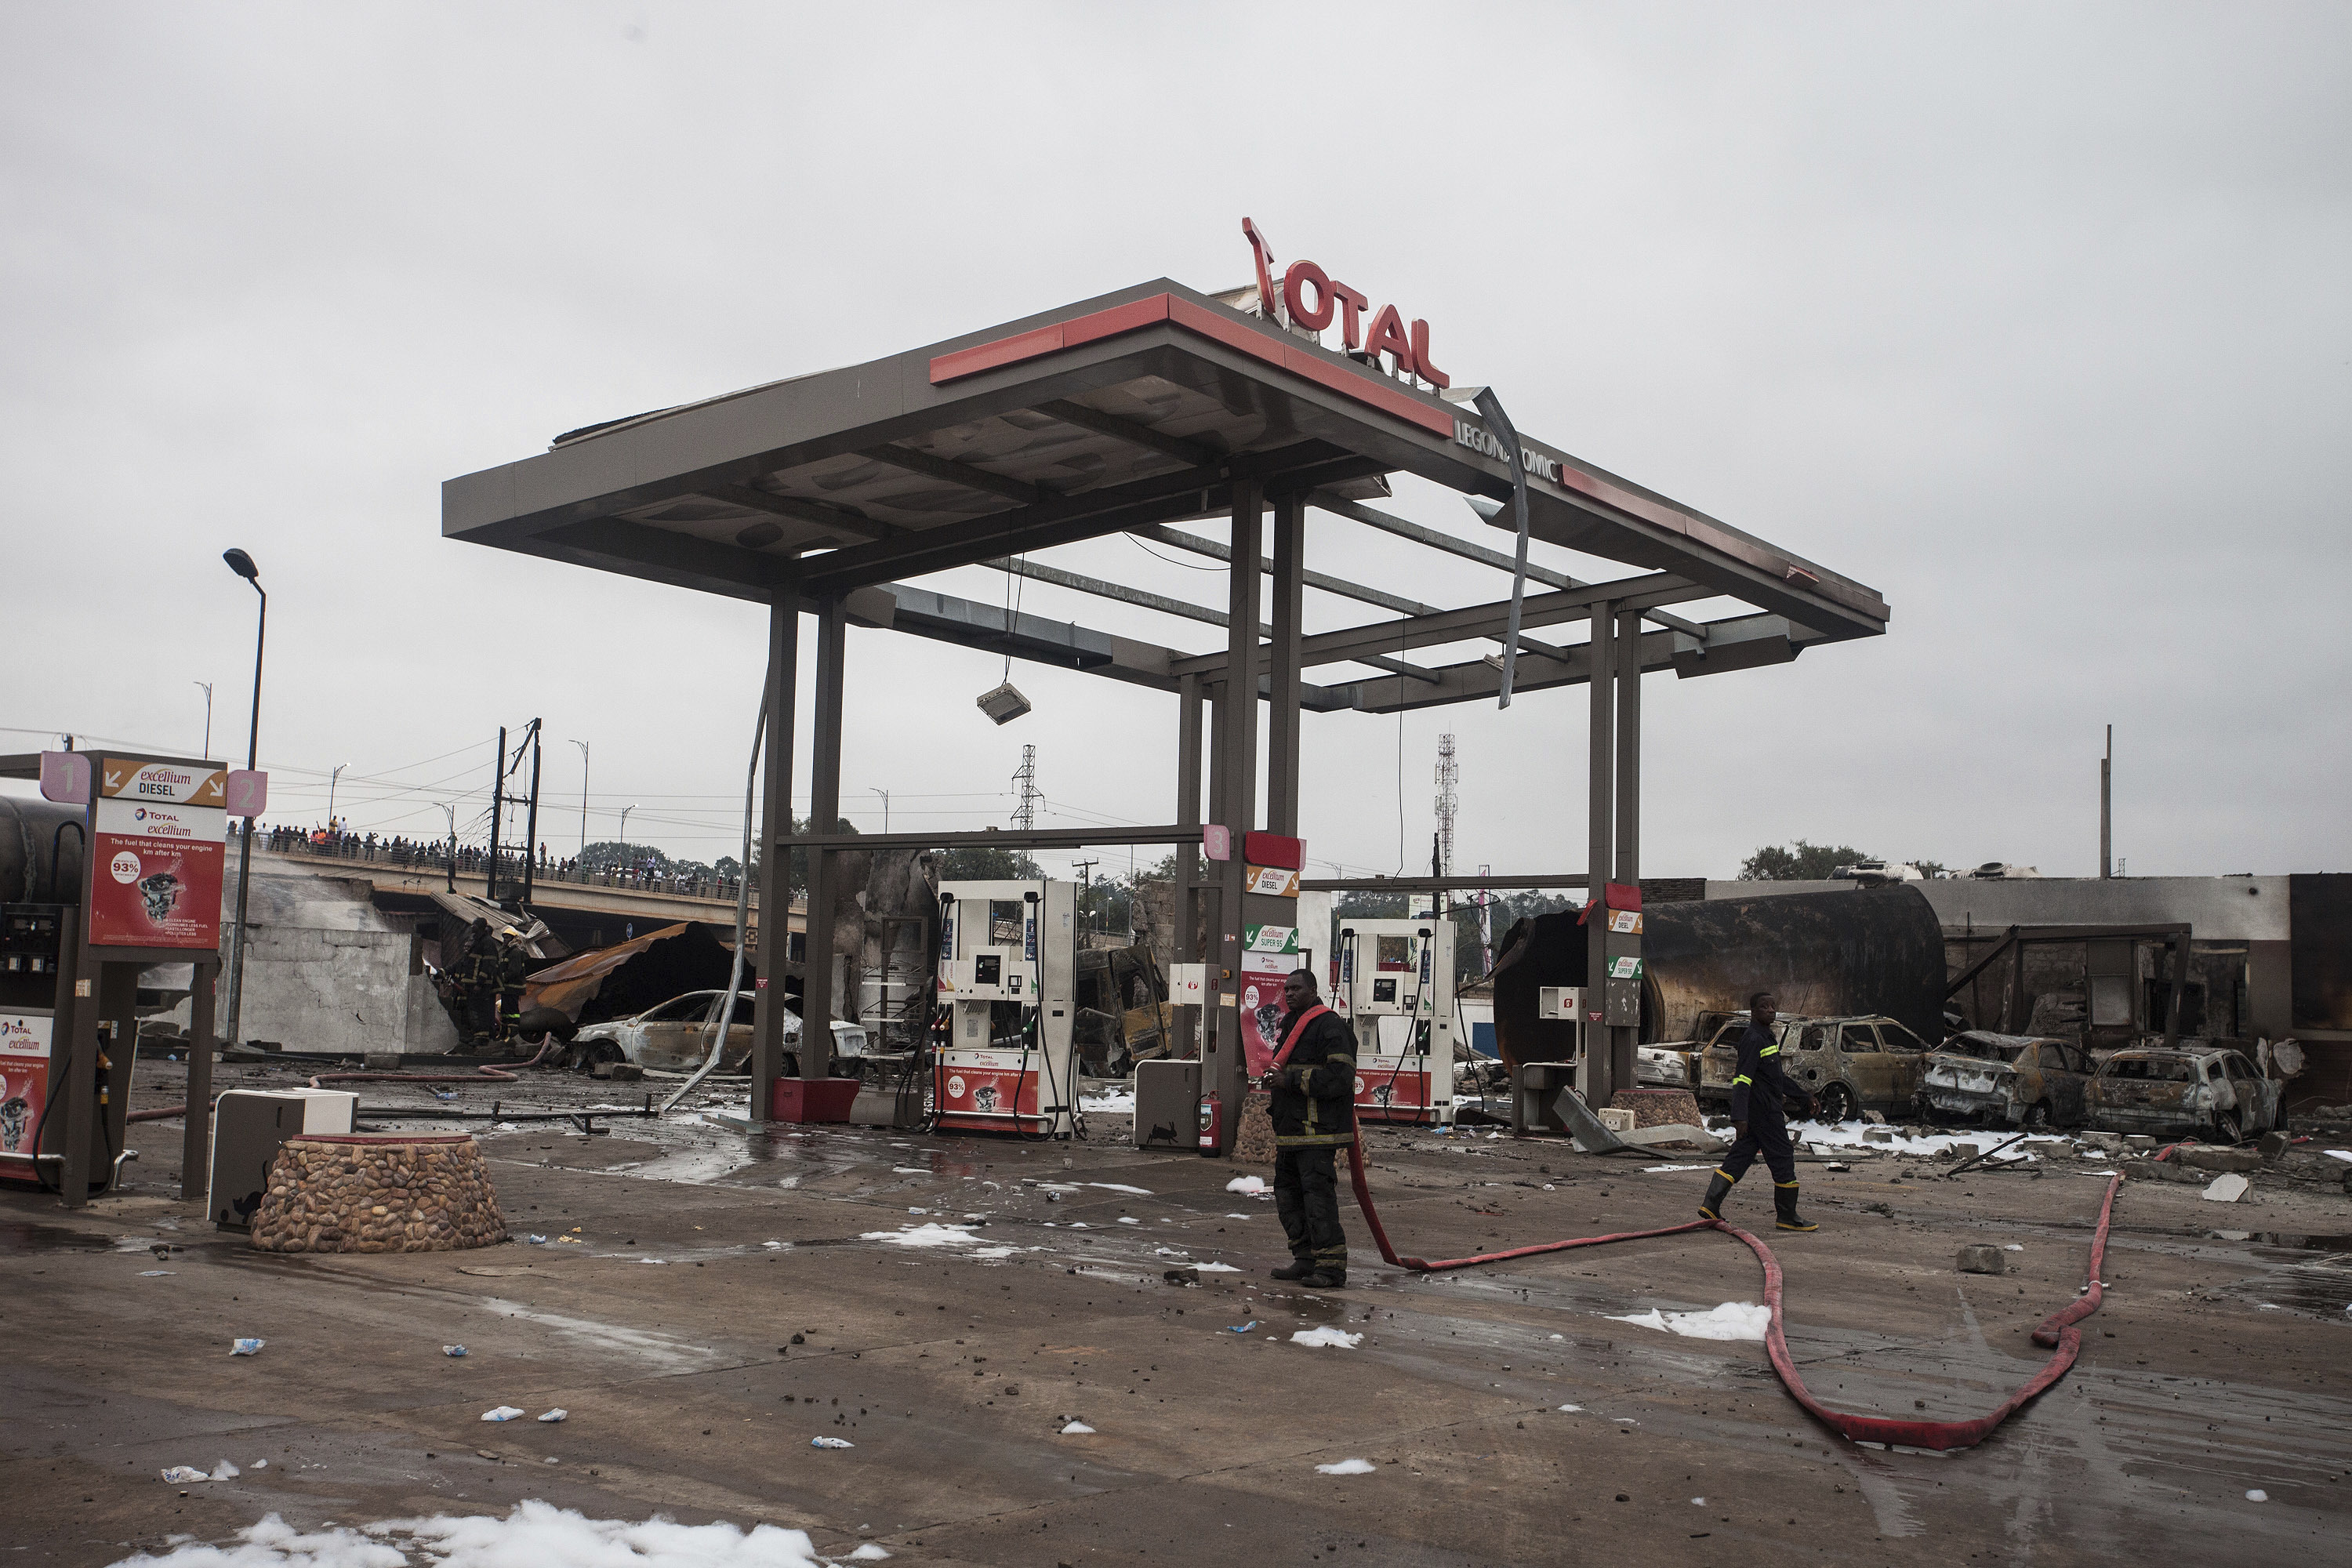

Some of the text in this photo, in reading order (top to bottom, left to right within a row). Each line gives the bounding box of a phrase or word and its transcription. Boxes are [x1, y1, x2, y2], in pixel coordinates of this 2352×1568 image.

[1242, 216, 1450, 390] TOTAL
[1454, 419, 1505, 461] LEGON
[60, 762, 74, 793] 1
[140, 769, 191, 785] excellium
[140, 782, 175, 796] DIESEL
[238, 779, 256, 808] 2
[149, 812, 179, 822] TOTAL
[147, 824, 191, 837] excellium
[1214, 831, 1223, 854] 3
[113, 862, 138, 873] 93%
[1261, 880, 1277, 890] DIESEL
[1261, 938, 1276, 946] SUPER
[11, 1025, 31, 1034] TOTAL
[9, 1038, 39, 1051] excellium
